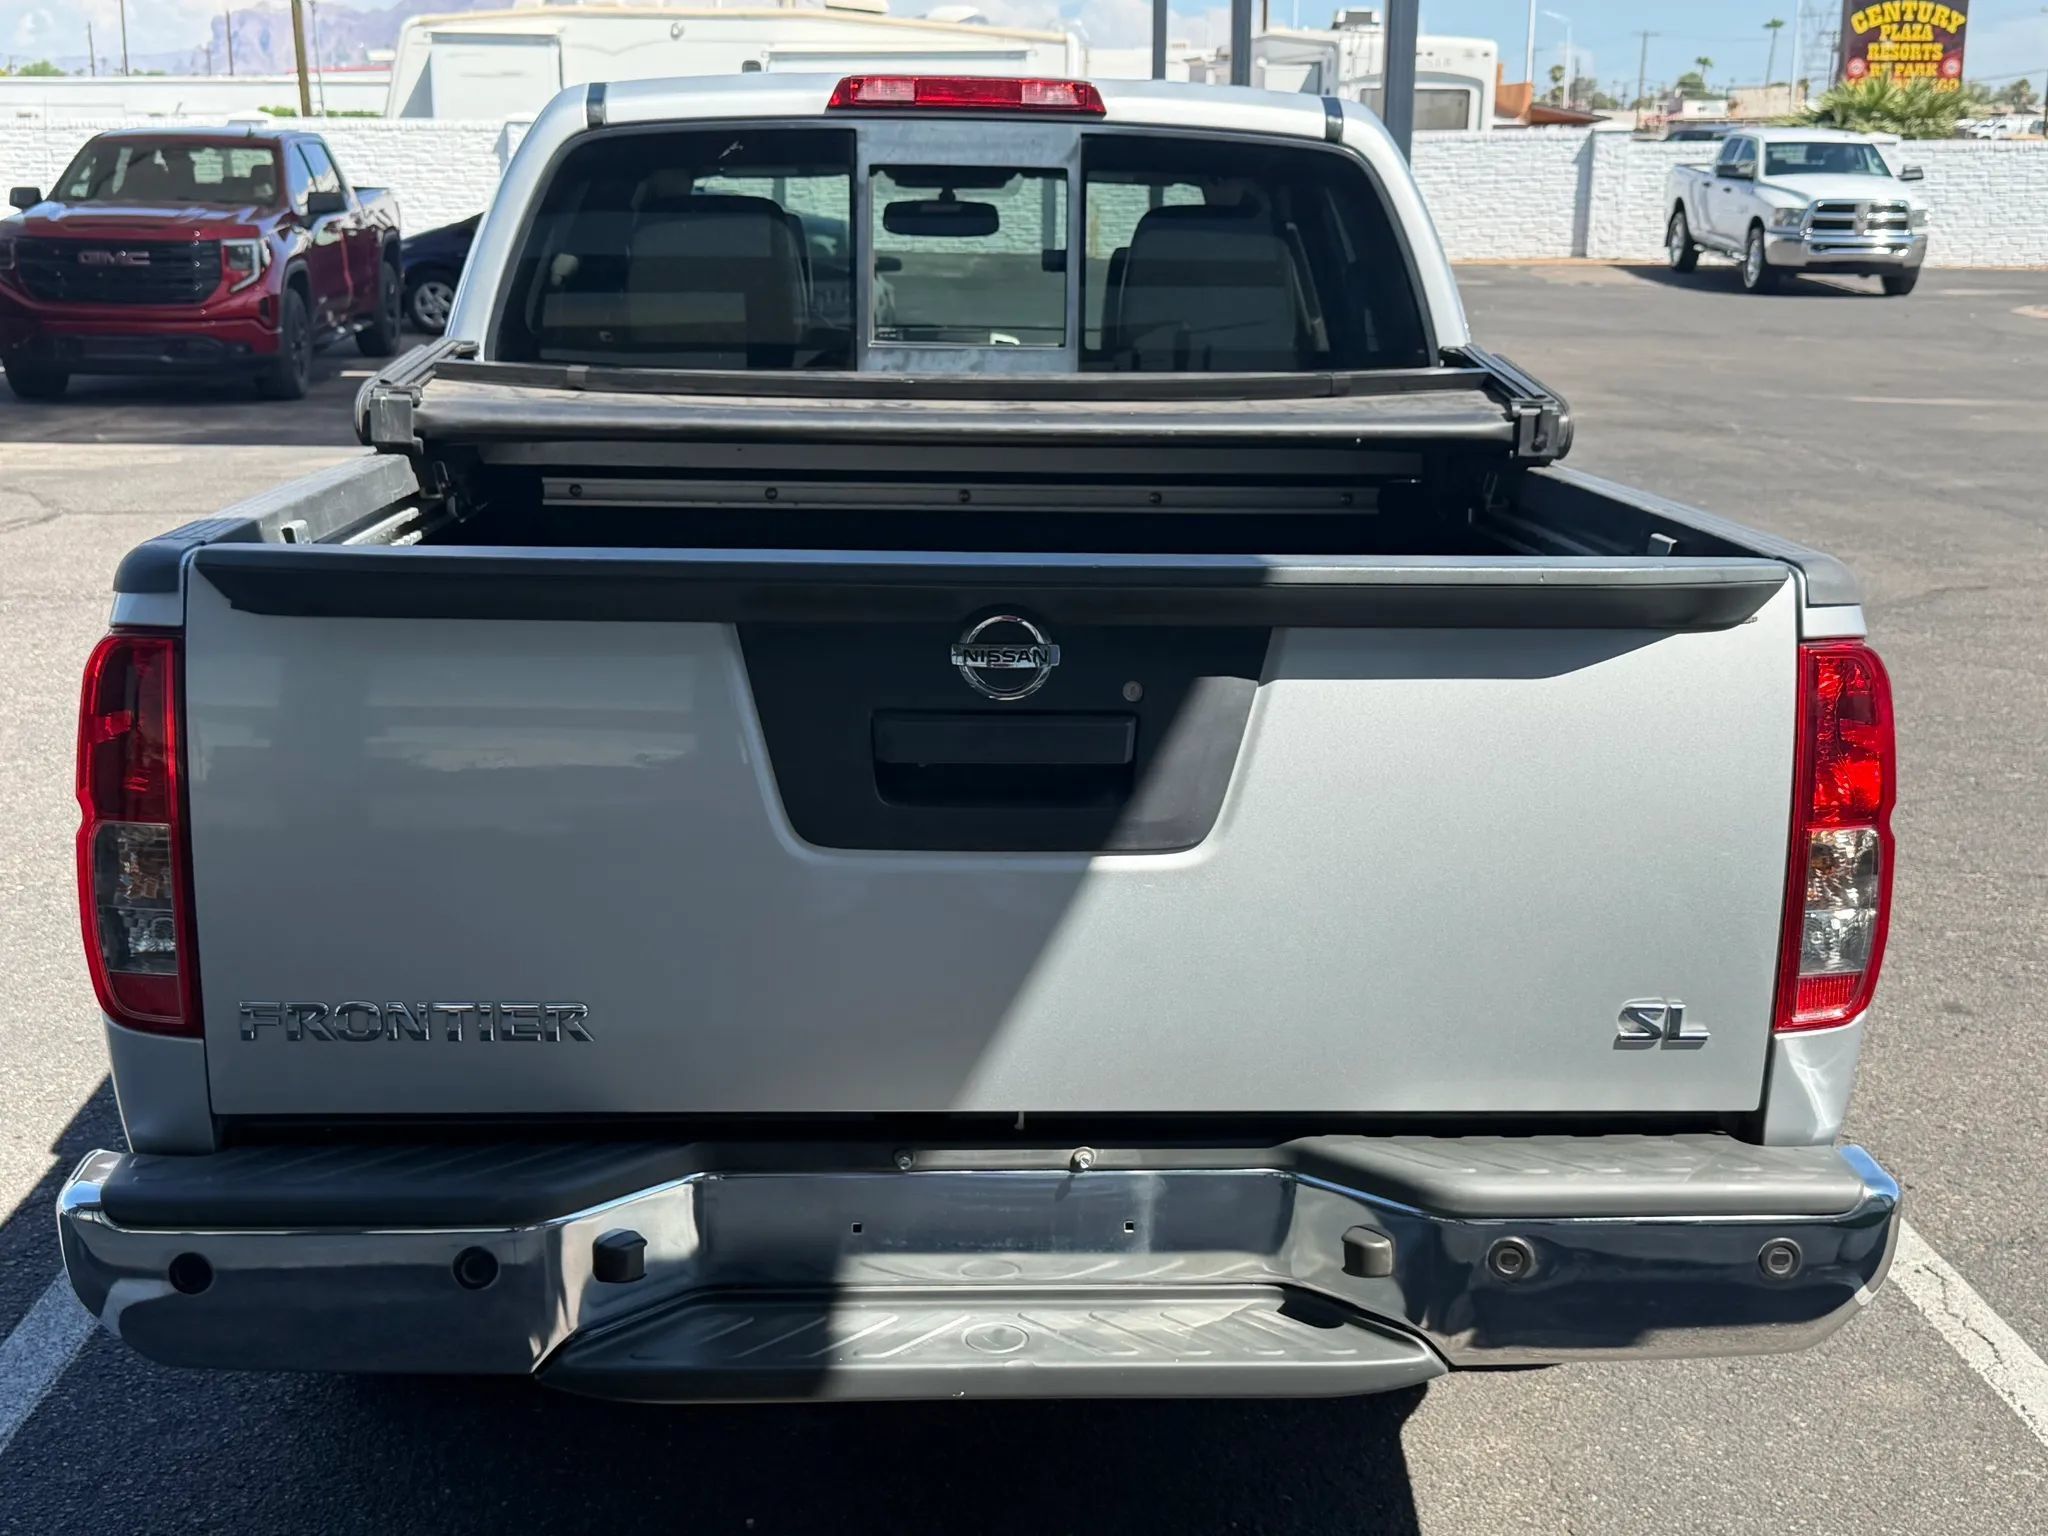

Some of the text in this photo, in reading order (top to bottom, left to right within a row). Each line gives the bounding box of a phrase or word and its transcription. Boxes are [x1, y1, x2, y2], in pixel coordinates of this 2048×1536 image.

[1851, 1, 1966, 34] CENTURY
[1879, 23, 1934, 41] PLAZA
[1867, 43, 1944, 61] RESORTS
[1893, 62, 1939, 77] PARK
[79, 251, 150, 265] GMC
[962, 648, 1049, 664] NISSAN
[238, 1000, 595, 1042] FRONTIER
[1616, 998, 1711, 1044] SL
